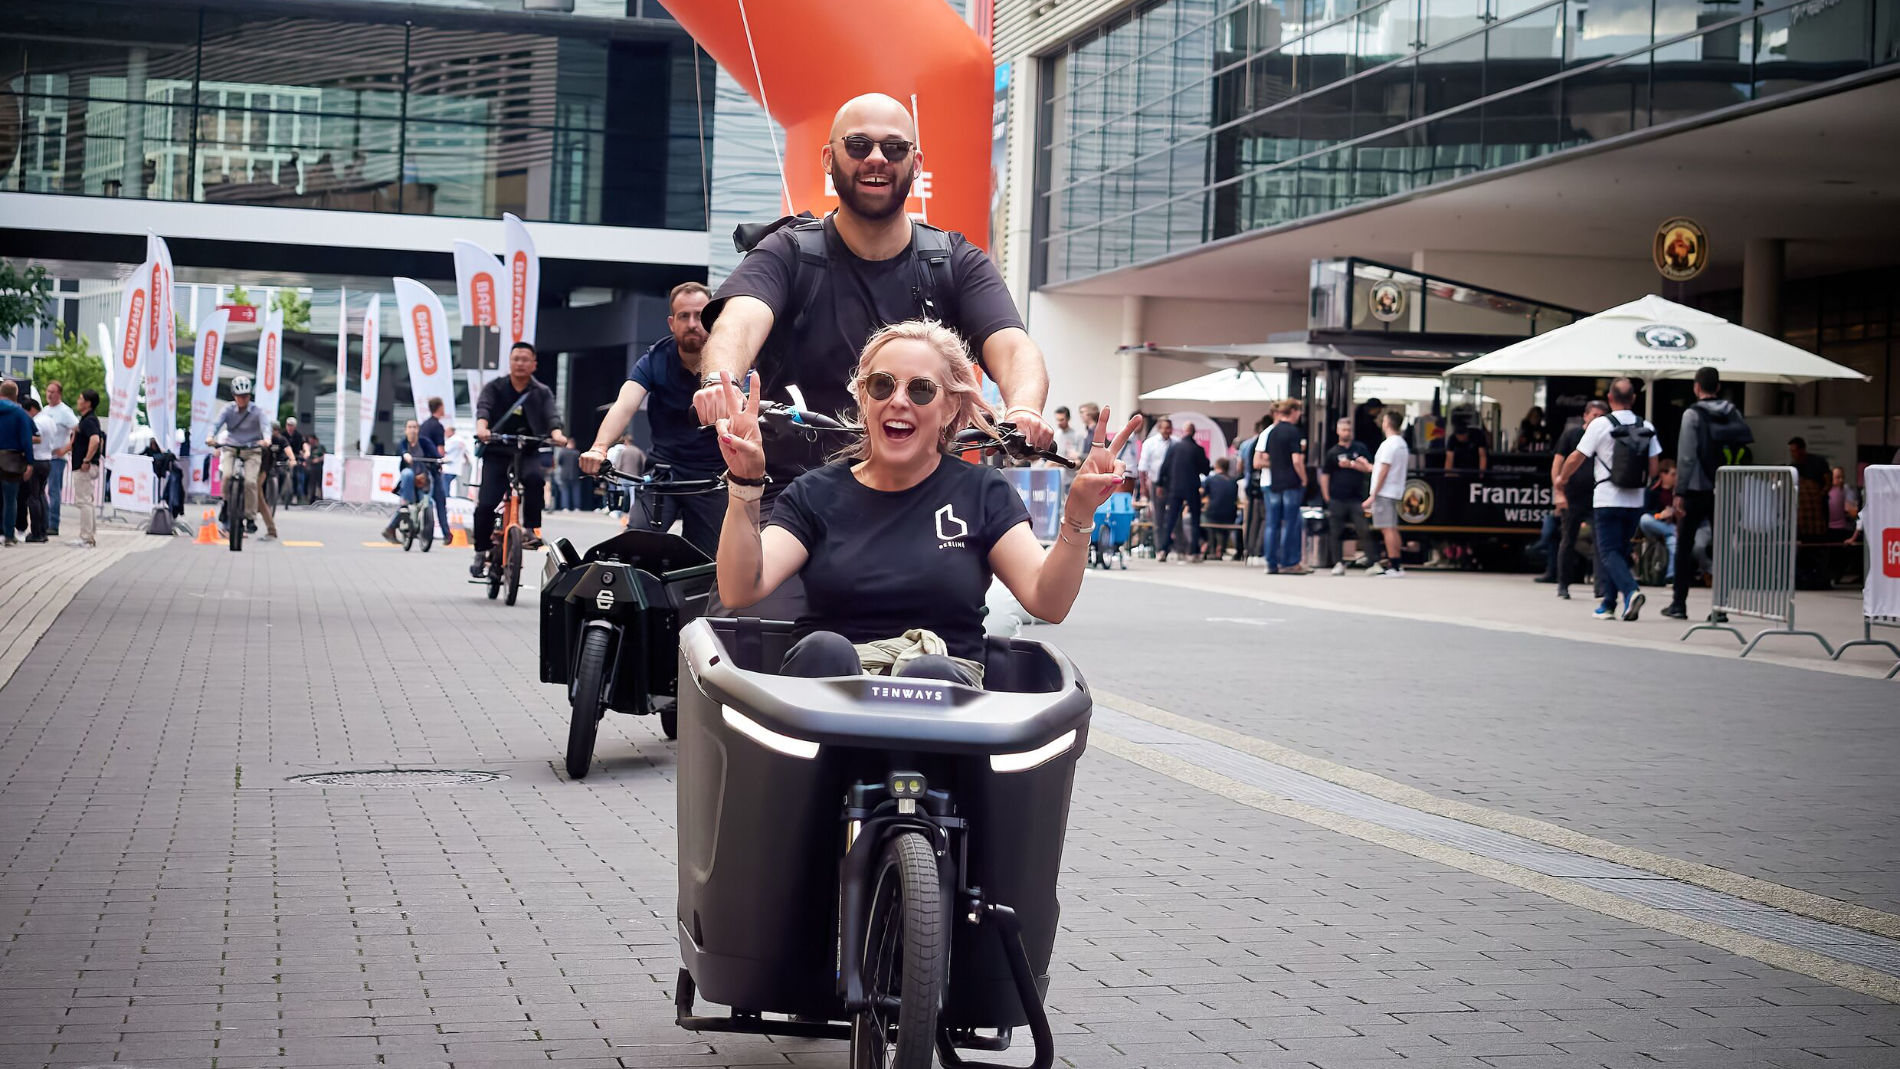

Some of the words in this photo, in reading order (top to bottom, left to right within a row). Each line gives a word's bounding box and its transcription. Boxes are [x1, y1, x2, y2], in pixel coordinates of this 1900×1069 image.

[475, 280, 492, 326] BAFA
[513, 260, 525, 336] BAFANG
[125, 296, 144, 360] BAFANG
[415, 311, 436, 369] BAFANG
[1504, 508, 1554, 522] WEISS
[872, 686, 943, 701] TENWAYS
